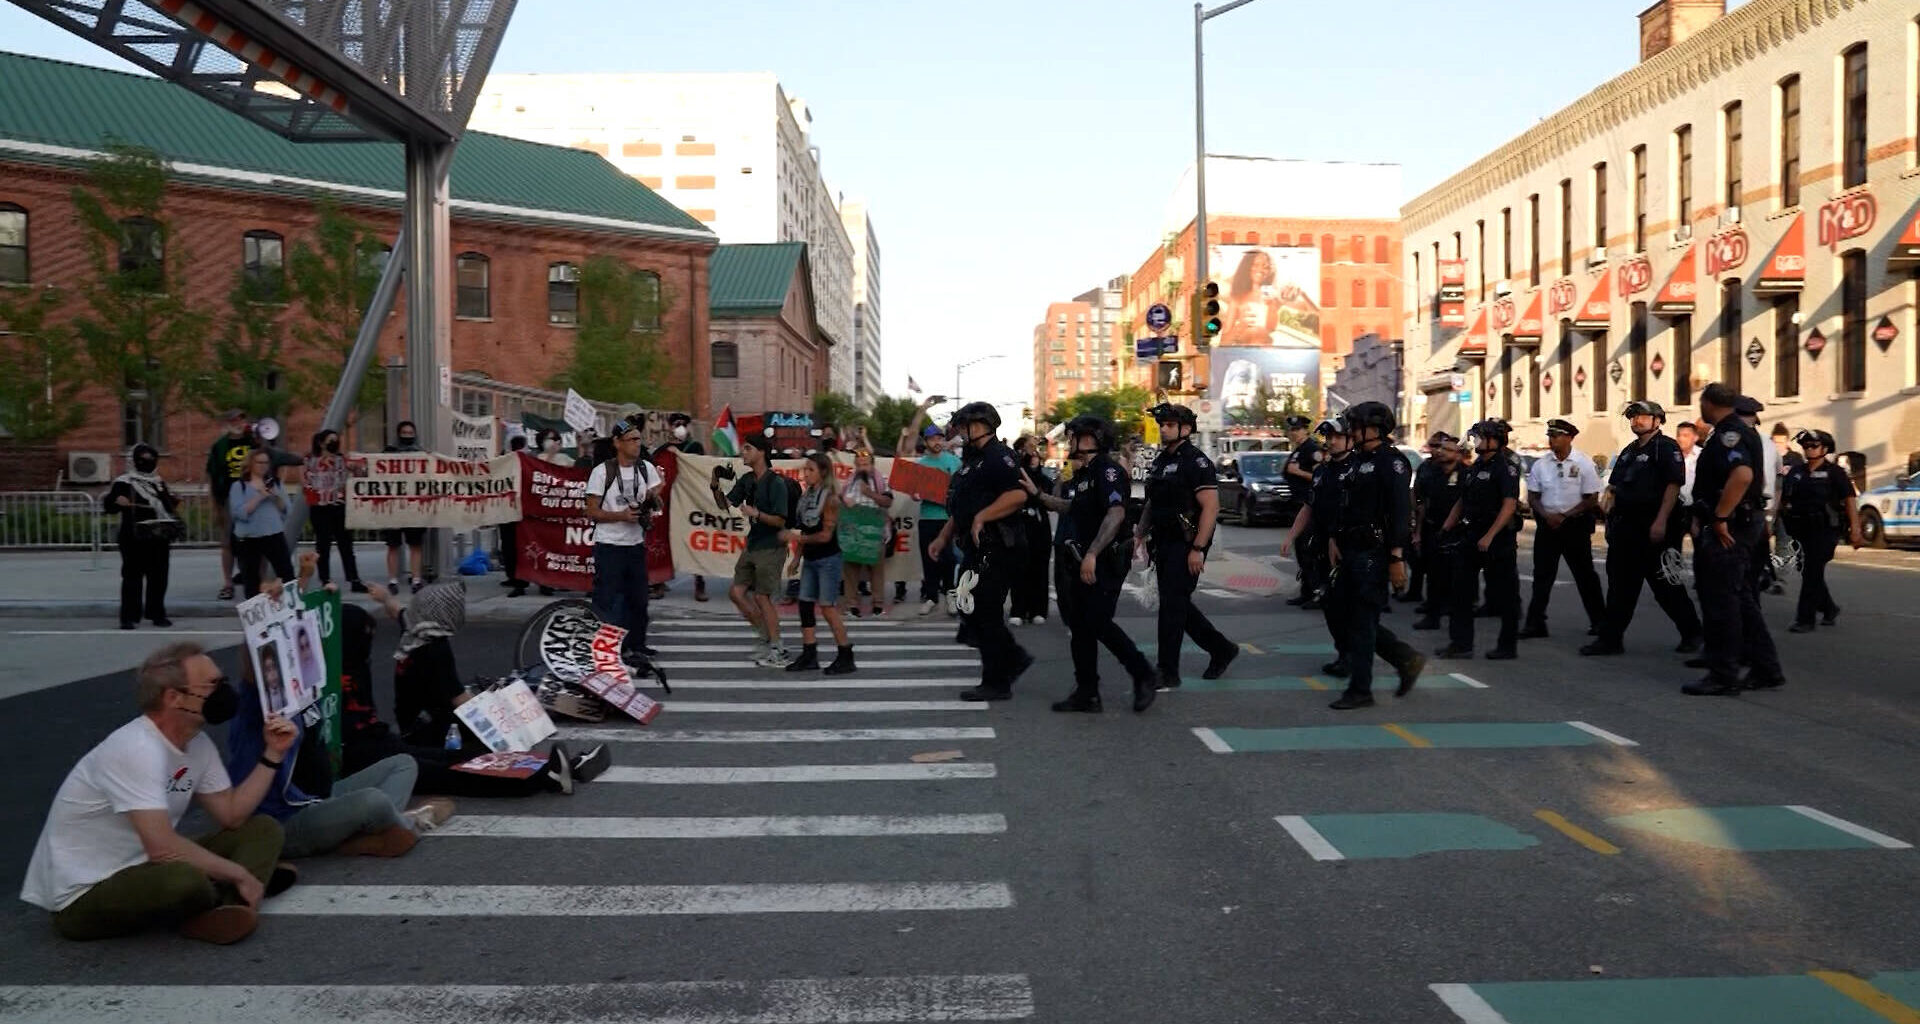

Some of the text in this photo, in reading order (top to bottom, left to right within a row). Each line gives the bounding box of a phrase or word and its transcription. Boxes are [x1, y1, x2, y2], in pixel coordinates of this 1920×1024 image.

[376, 459, 490, 476] SHUT DOWN
[354, 476, 515, 496] CRYE PRECISION
[689, 511, 745, 532] CRYE
